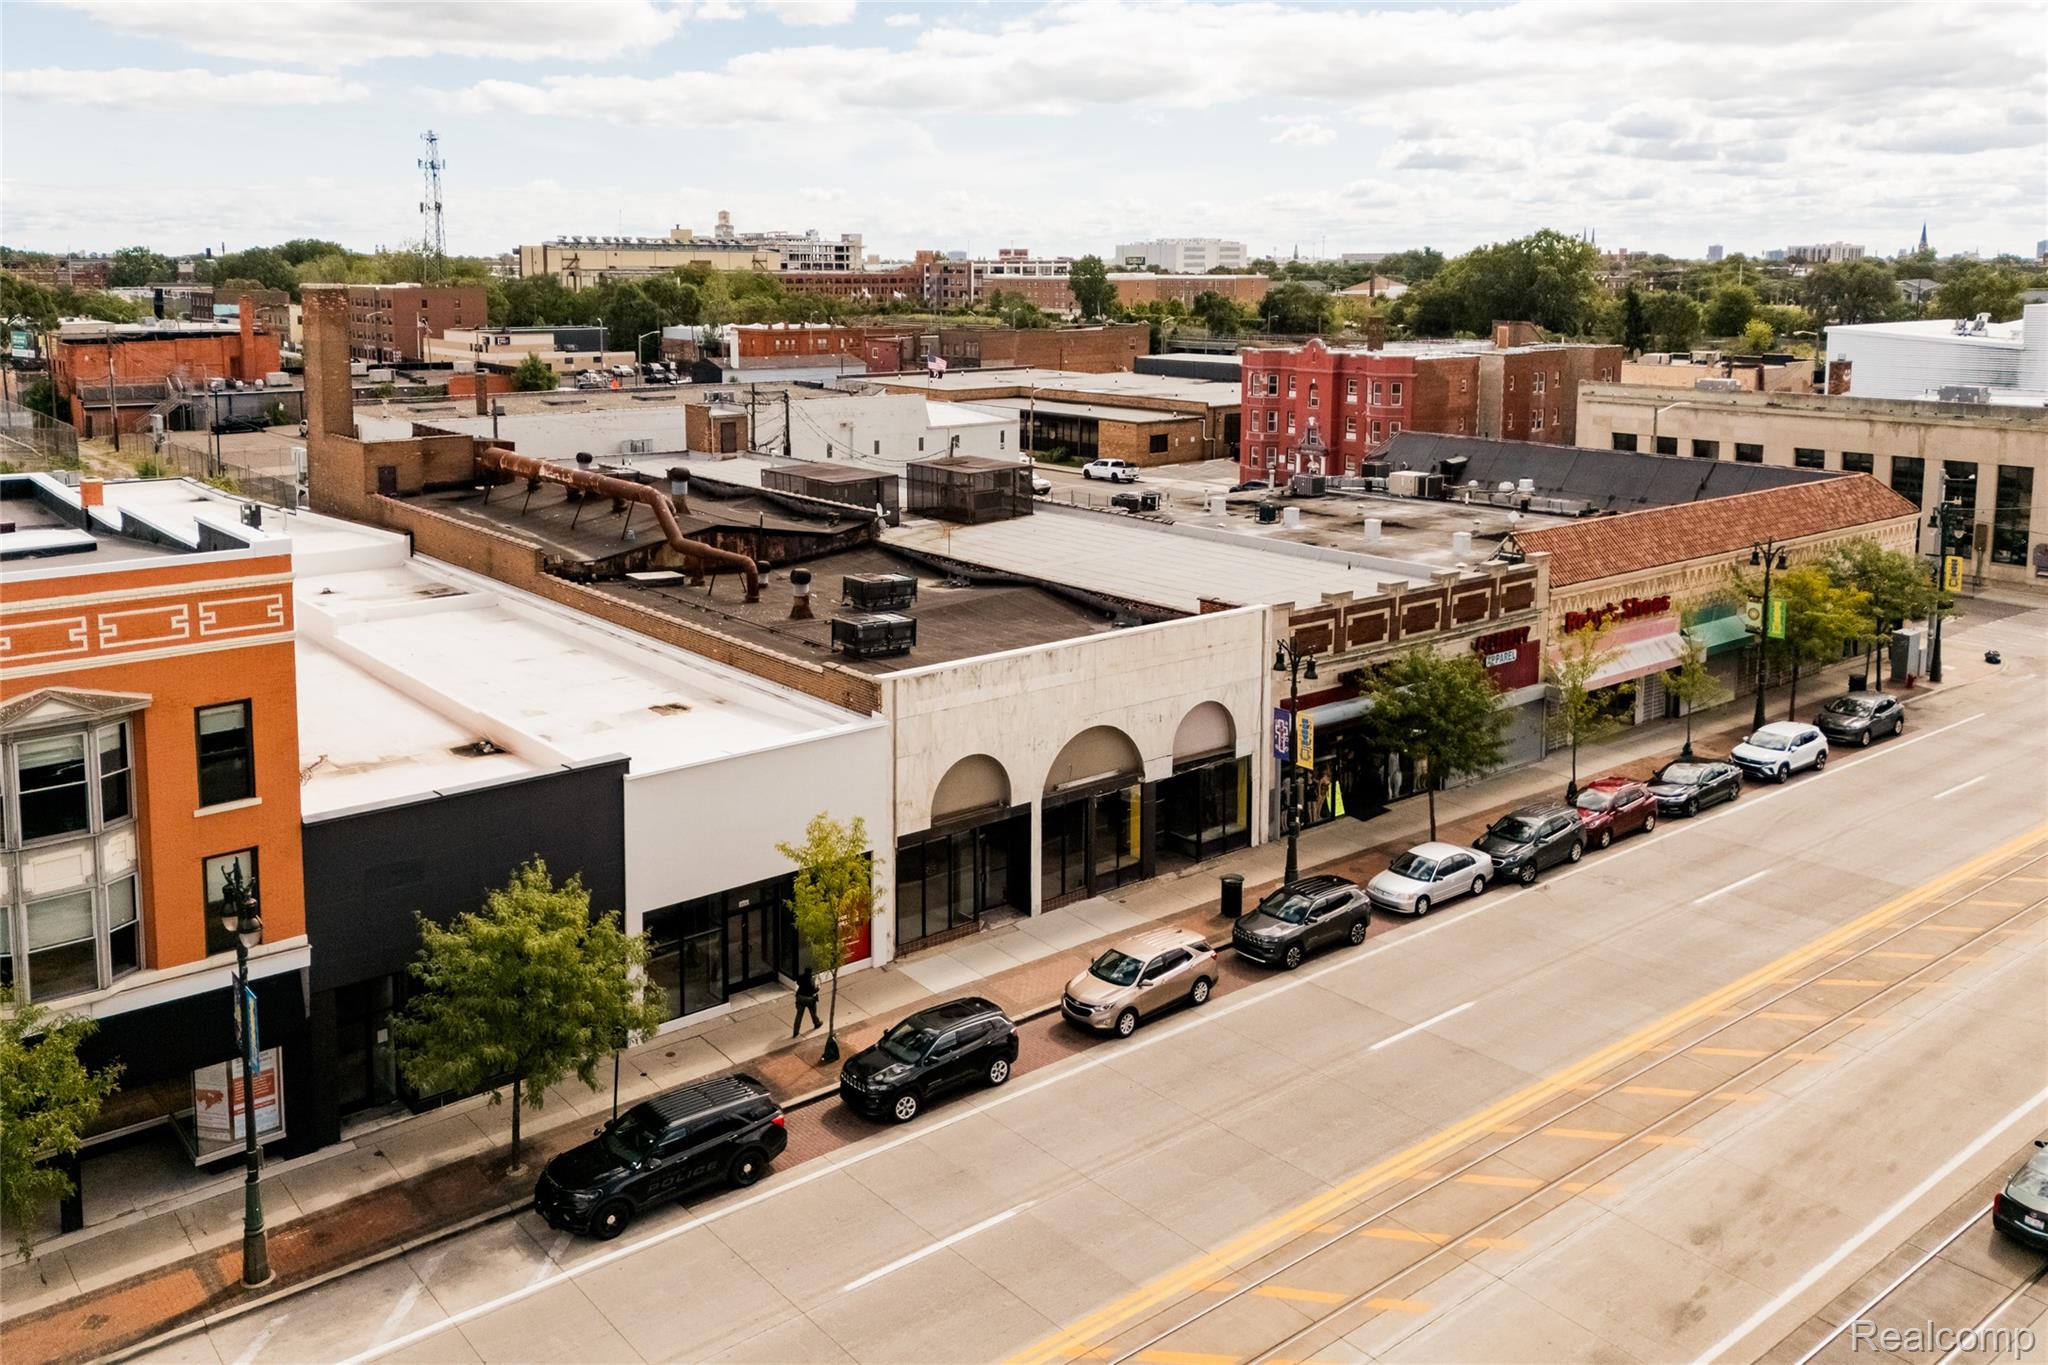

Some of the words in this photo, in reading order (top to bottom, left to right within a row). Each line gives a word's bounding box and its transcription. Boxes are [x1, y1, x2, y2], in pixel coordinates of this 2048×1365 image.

[1621, 596, 1670, 619] Shoes
[1487, 650, 1516, 667] APPAREL
[648, 1161, 719, 1193] POLICE
